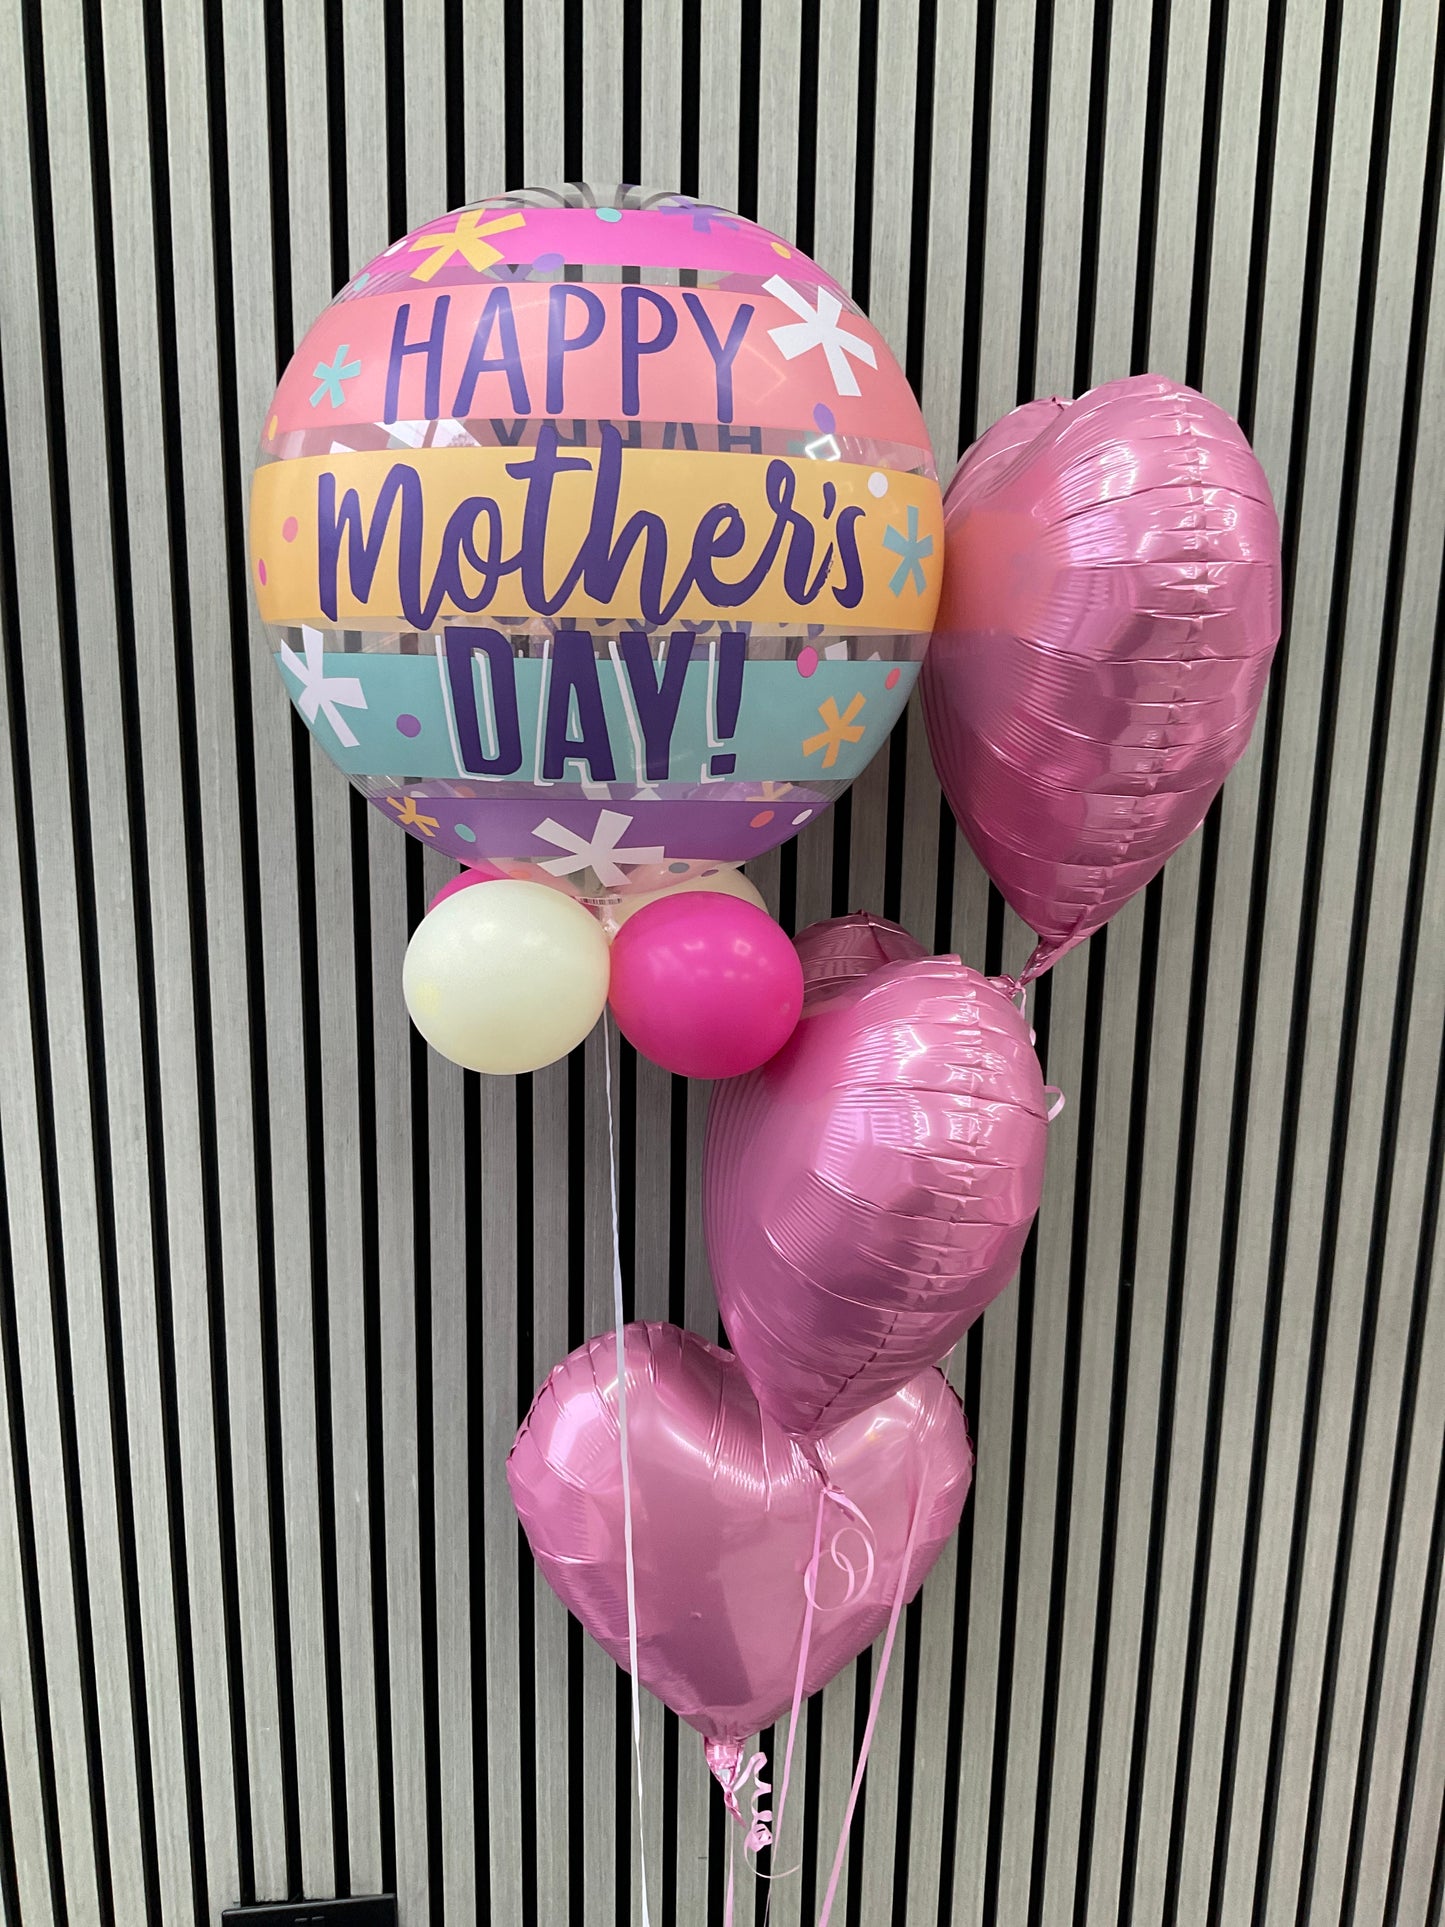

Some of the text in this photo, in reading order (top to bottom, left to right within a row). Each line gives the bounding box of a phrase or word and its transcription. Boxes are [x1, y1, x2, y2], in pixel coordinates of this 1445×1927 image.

[383, 285, 755, 425] HAPPY
[318, 424, 866, 630] Mother's
[438, 626, 746, 786] DAY!
